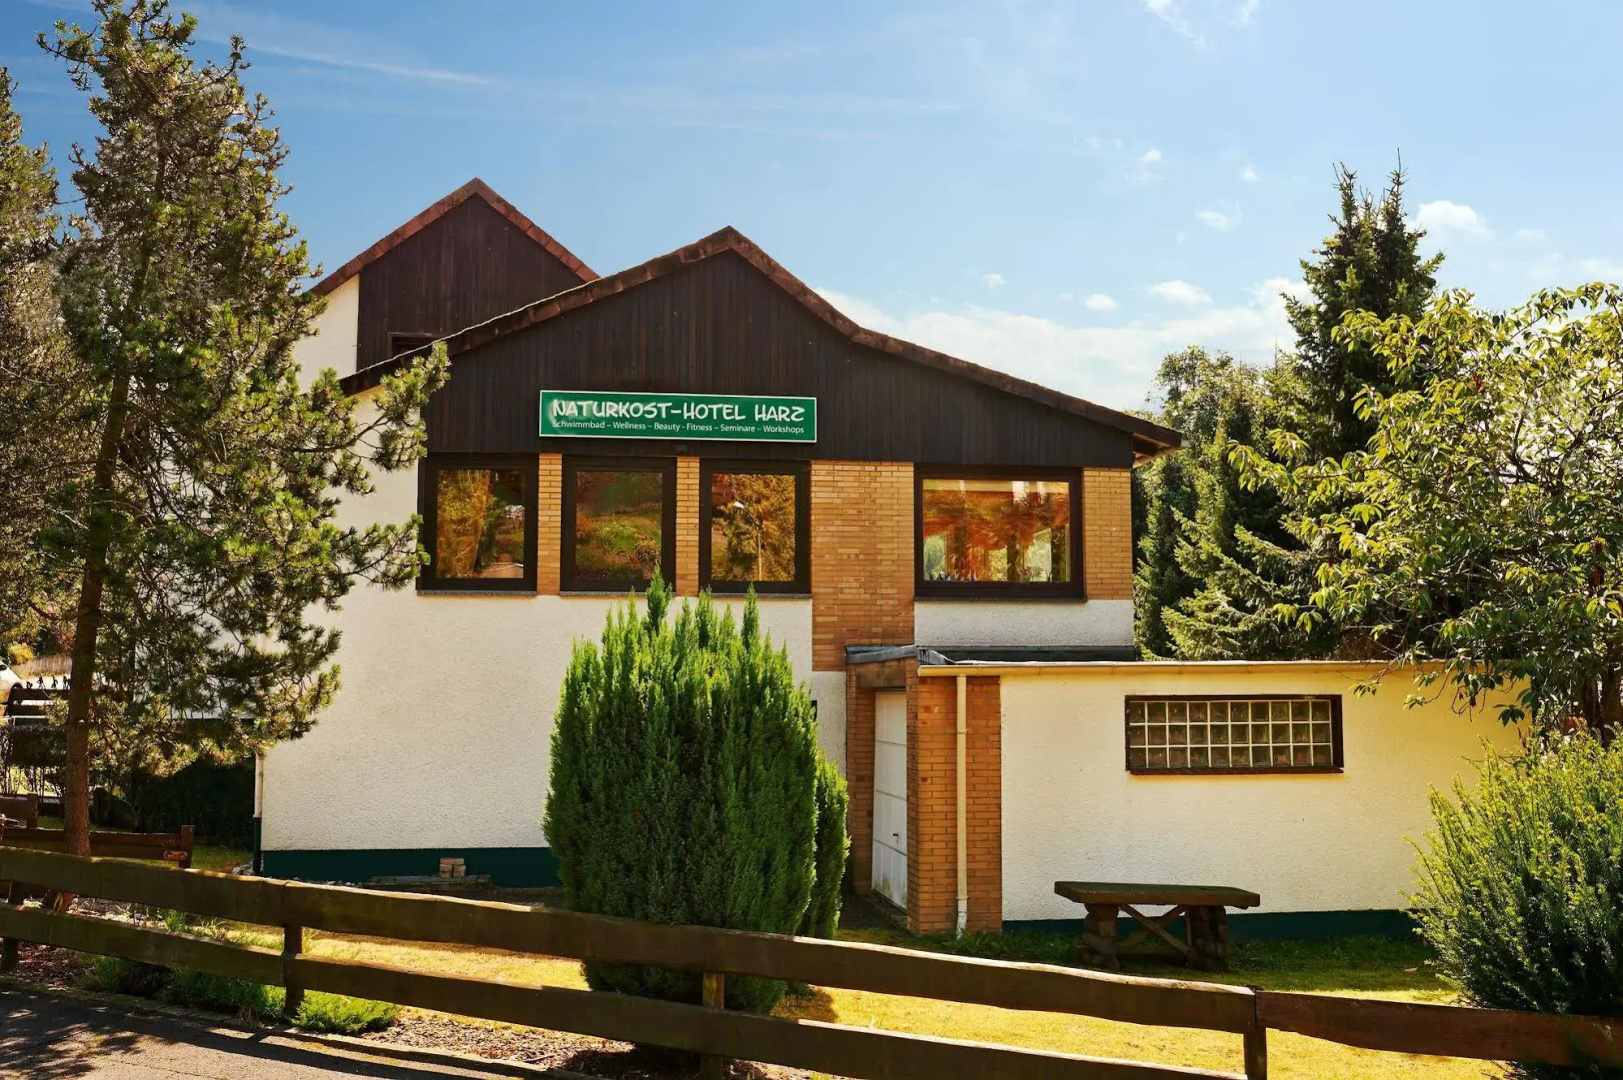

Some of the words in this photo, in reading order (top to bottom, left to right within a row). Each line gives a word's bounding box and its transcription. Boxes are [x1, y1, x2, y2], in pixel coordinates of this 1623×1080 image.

[552, 399, 747, 420] NATURKOST-HOTEL
[754, 404, 806, 422] HARZ
[552, 420, 606, 429] Schwimmbad
[613, 421, 647, 430] Wellness
[654, 422, 681, 431] Beauty
[686, 423, 713, 431] Fitness
[720, 424, 756, 432] Seminare
[763, 424, 805, 434] Workshops
